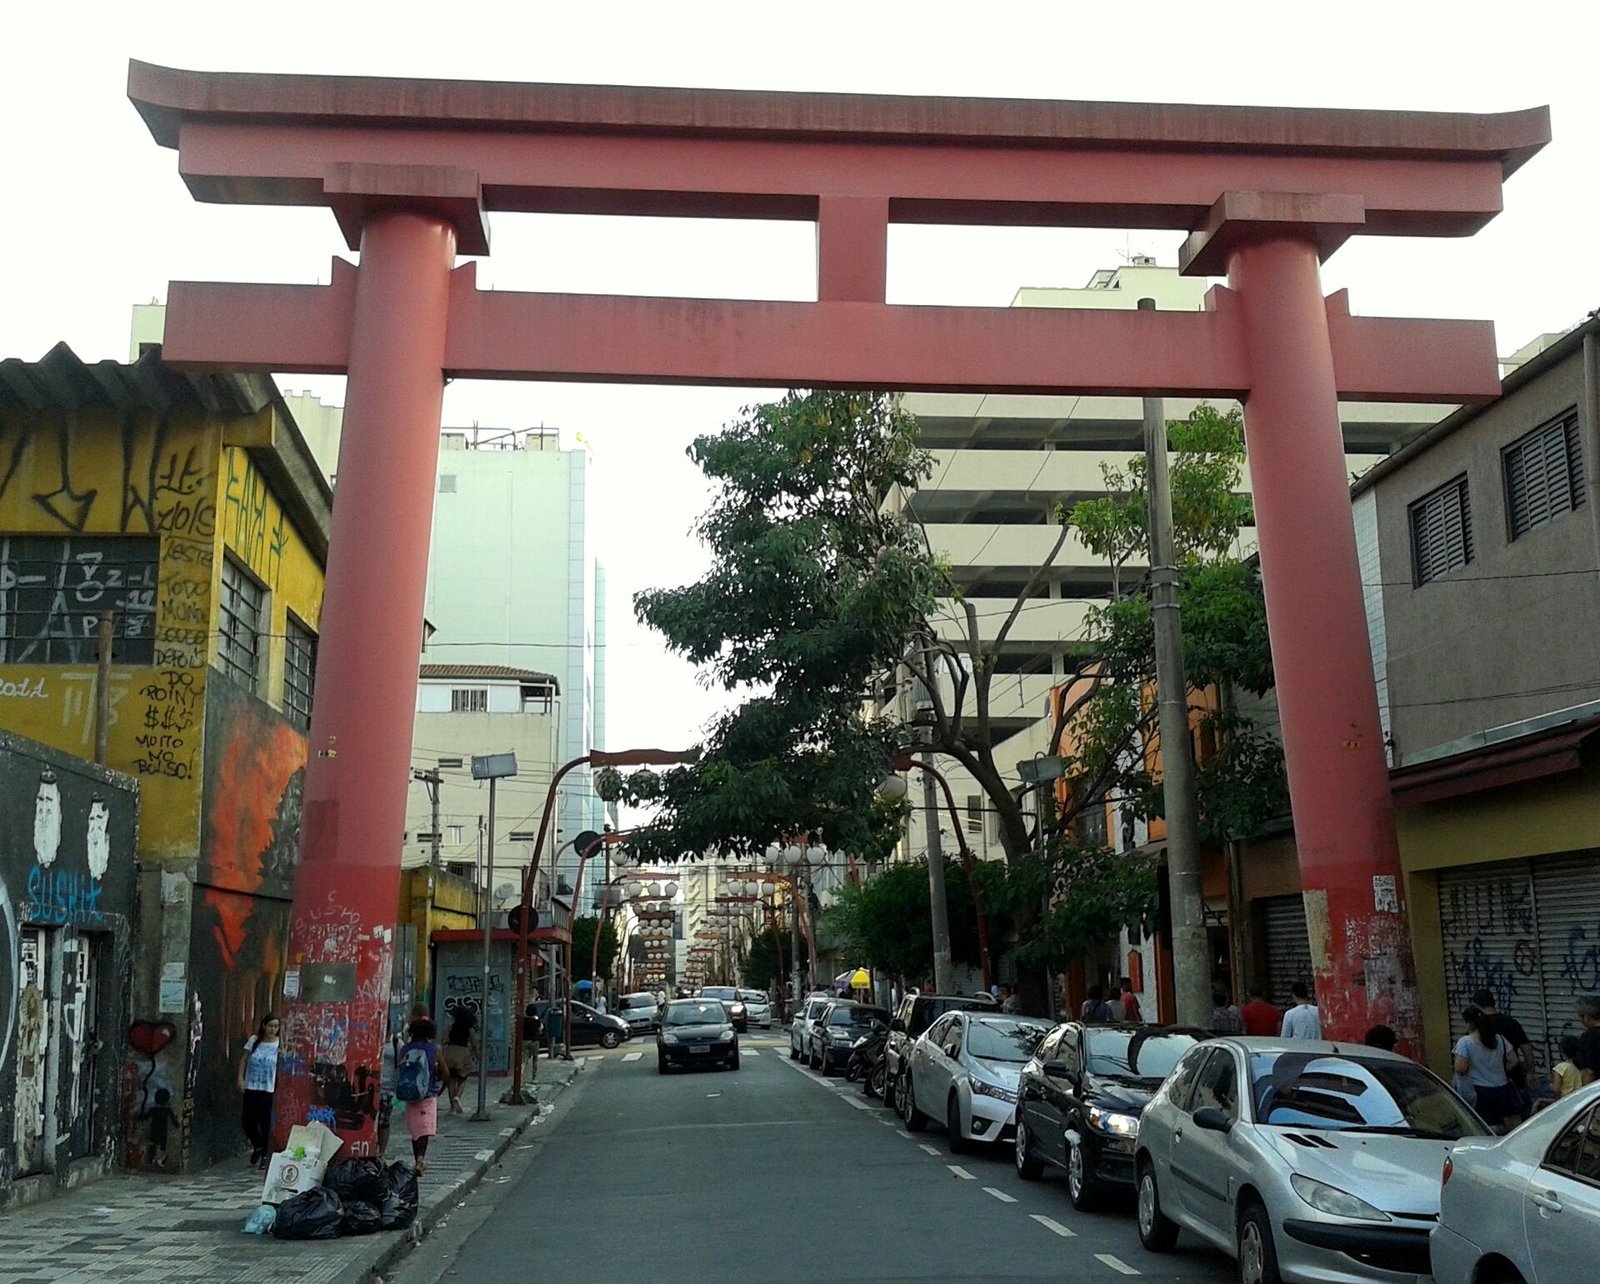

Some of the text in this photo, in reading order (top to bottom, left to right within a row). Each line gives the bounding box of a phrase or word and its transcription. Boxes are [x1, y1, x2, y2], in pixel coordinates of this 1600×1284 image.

[161, 671, 194, 686] DO
[139, 685, 206, 709] POINT
[148, 749, 174, 762] NO
